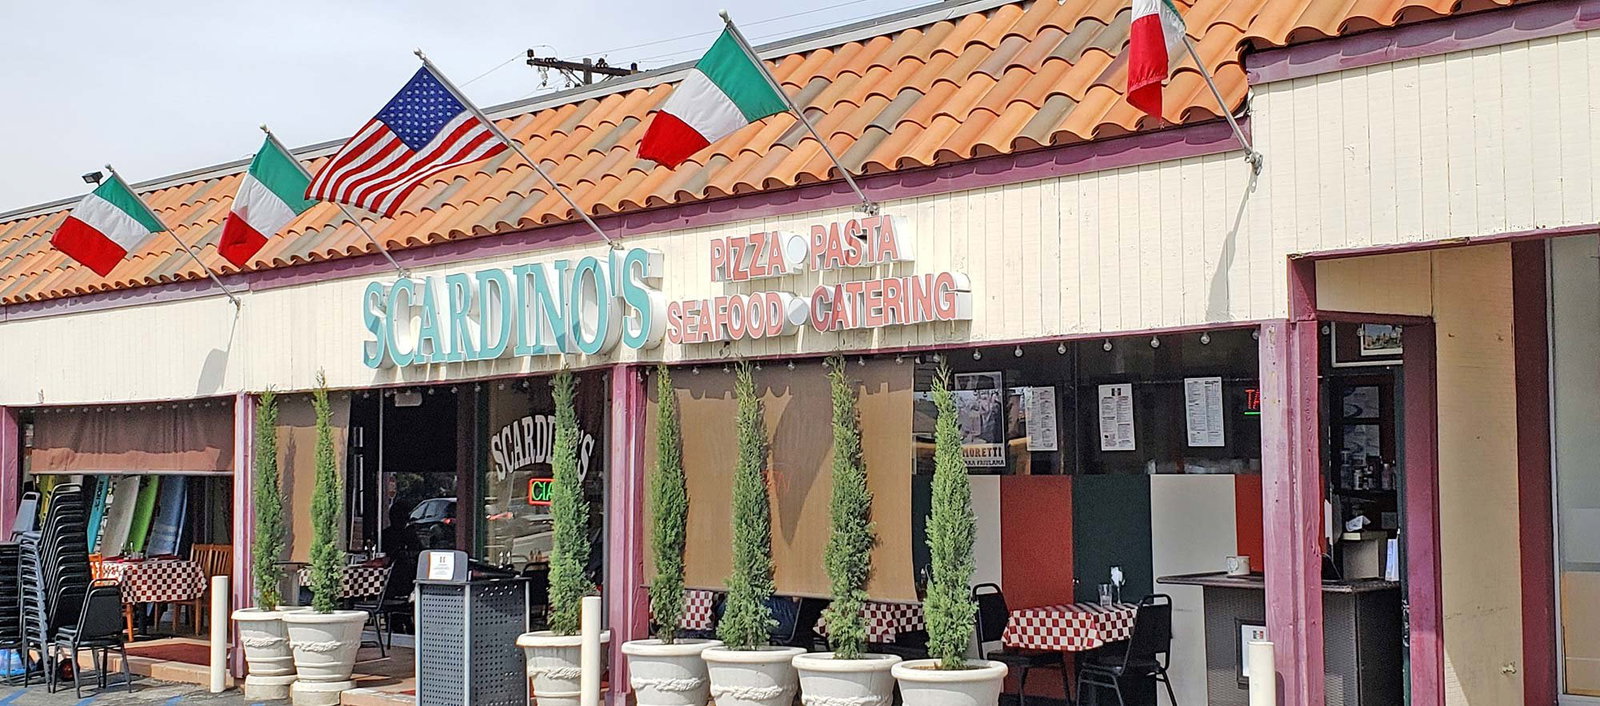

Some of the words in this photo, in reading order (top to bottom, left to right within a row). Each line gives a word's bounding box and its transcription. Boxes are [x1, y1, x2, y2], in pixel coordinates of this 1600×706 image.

[710, 231, 785, 282] PIZZA
[811, 214, 898, 271] PASTA
[363, 247, 653, 369] SCARDINO'S
[667, 291, 784, 344] SEAFOOD
[811, 271, 957, 332] CATERING
[490, 415, 595, 482] SCARDI'S
